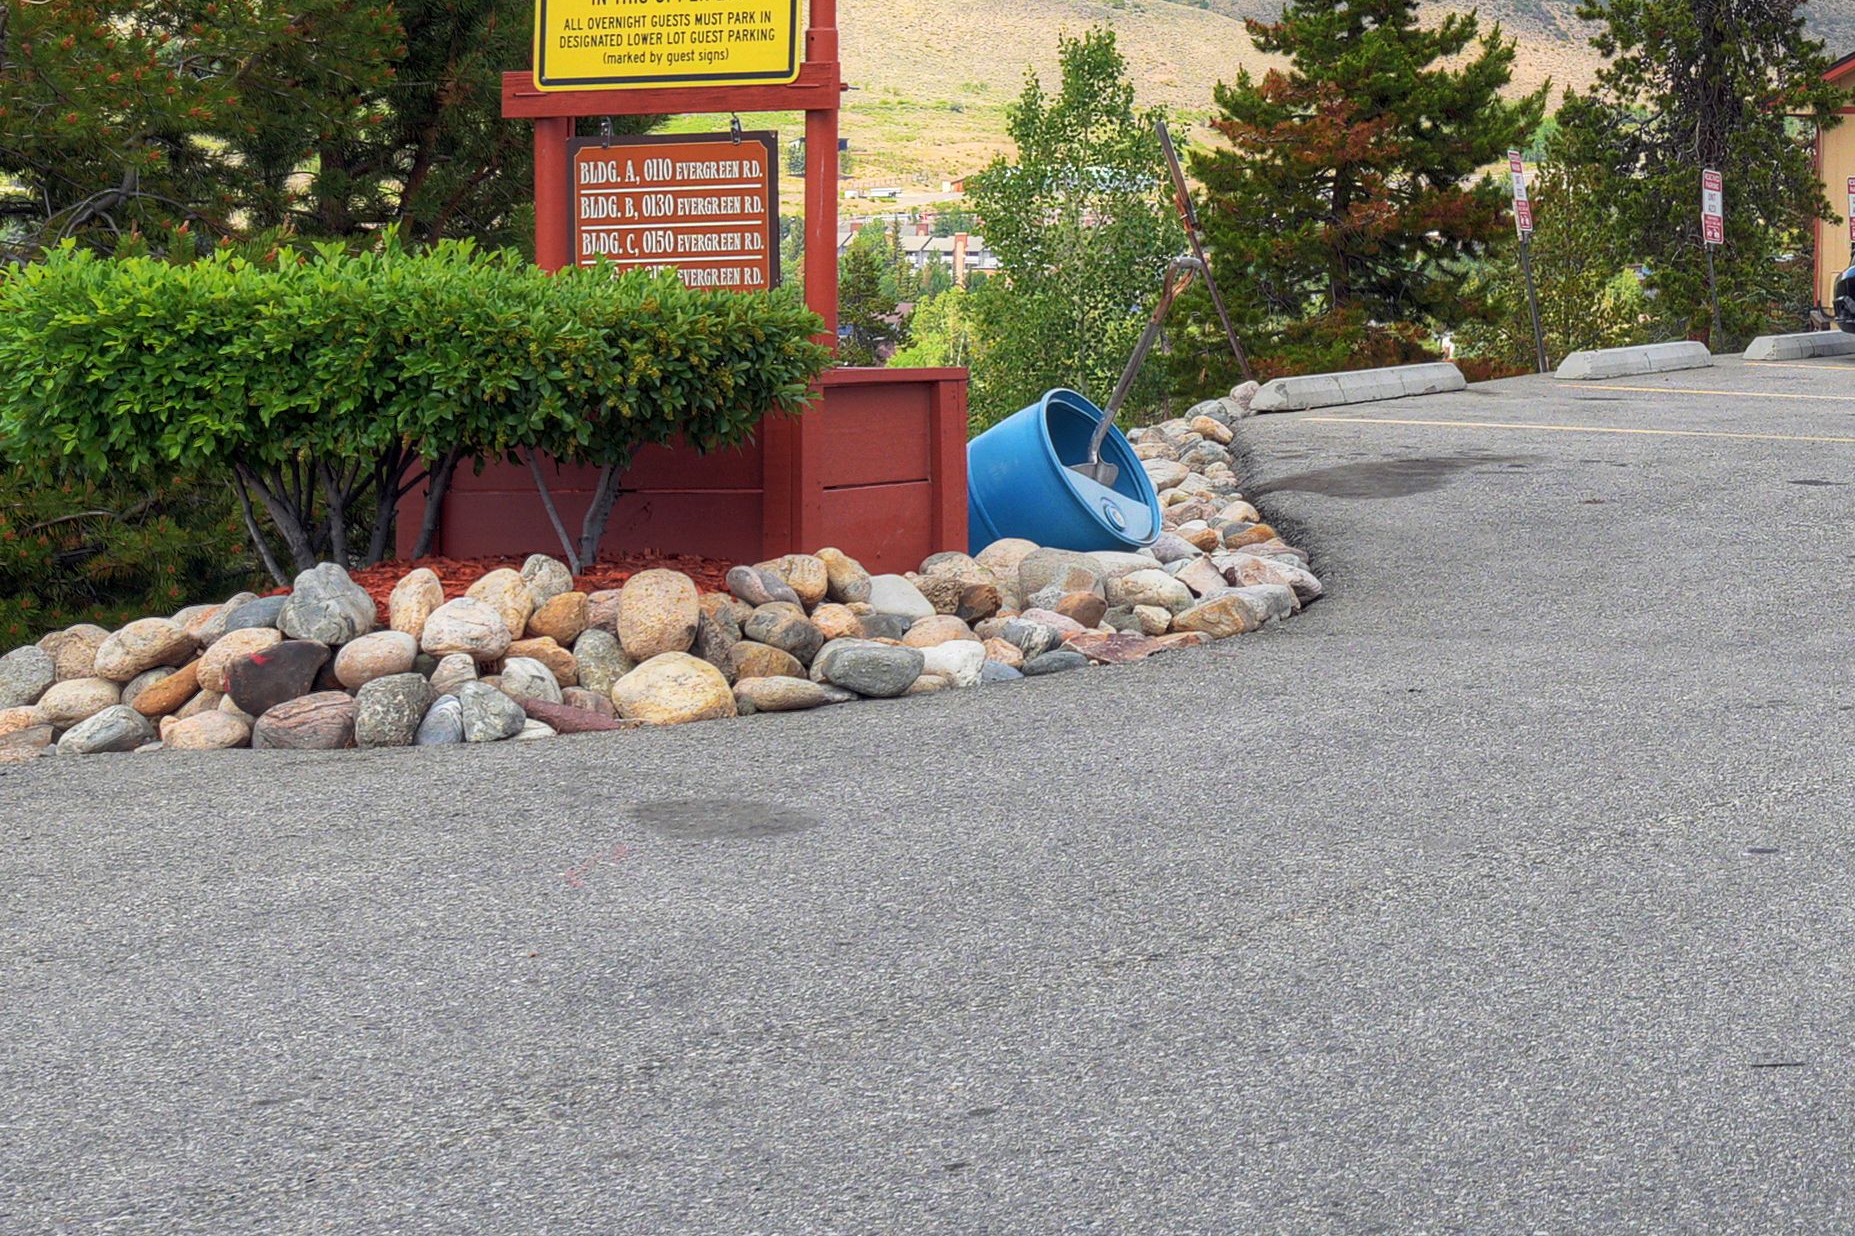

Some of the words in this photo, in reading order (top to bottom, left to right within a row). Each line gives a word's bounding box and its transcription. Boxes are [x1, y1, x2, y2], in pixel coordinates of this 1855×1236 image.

[564, 18, 583, 30] ALL
[588, 15, 646, 30] OVERNIGHT
[651, 14, 690, 27] GUESTS
[694, 13, 722, 26] MUST
[728, 12, 754, 24] PARK
[761, 11, 771, 23] IN
[560, 34, 623, 48] DESIGNATED
[628, 32, 662, 46] LOWER
[667, 31, 686, 44] LOT
[690, 30, 723, 44] GUEST
[728, 28, 775, 42] PARKING
[603, 50, 645, 65] (marked
[650, 50, 662, 65] by
[667, 51, 694, 66] guest
[699, 48, 729, 64] signs)
[580, 161, 621, 184] BLDG.
[625, 160, 640, 184] A,
[644, 158, 672, 181] 0110
[675, 161, 739, 180] EVERGREEN
[743, 160, 763, 178] RD.
[581, 196, 621, 219] BLDG.
[625, 197, 638, 220] B,
[642, 194, 673, 217] 0130
[678, 196, 740, 215] EVERGREEN
[745, 196, 764, 213] RD.
[582, 232, 623, 255] BLDG.
[627, 234, 639, 256] C,
[643, 230, 673, 253] 0150
[678, 233, 740, 252] EVERGREEN
[745, 233, 764, 250] RD.
[744, 267, 763, 284] RD.
